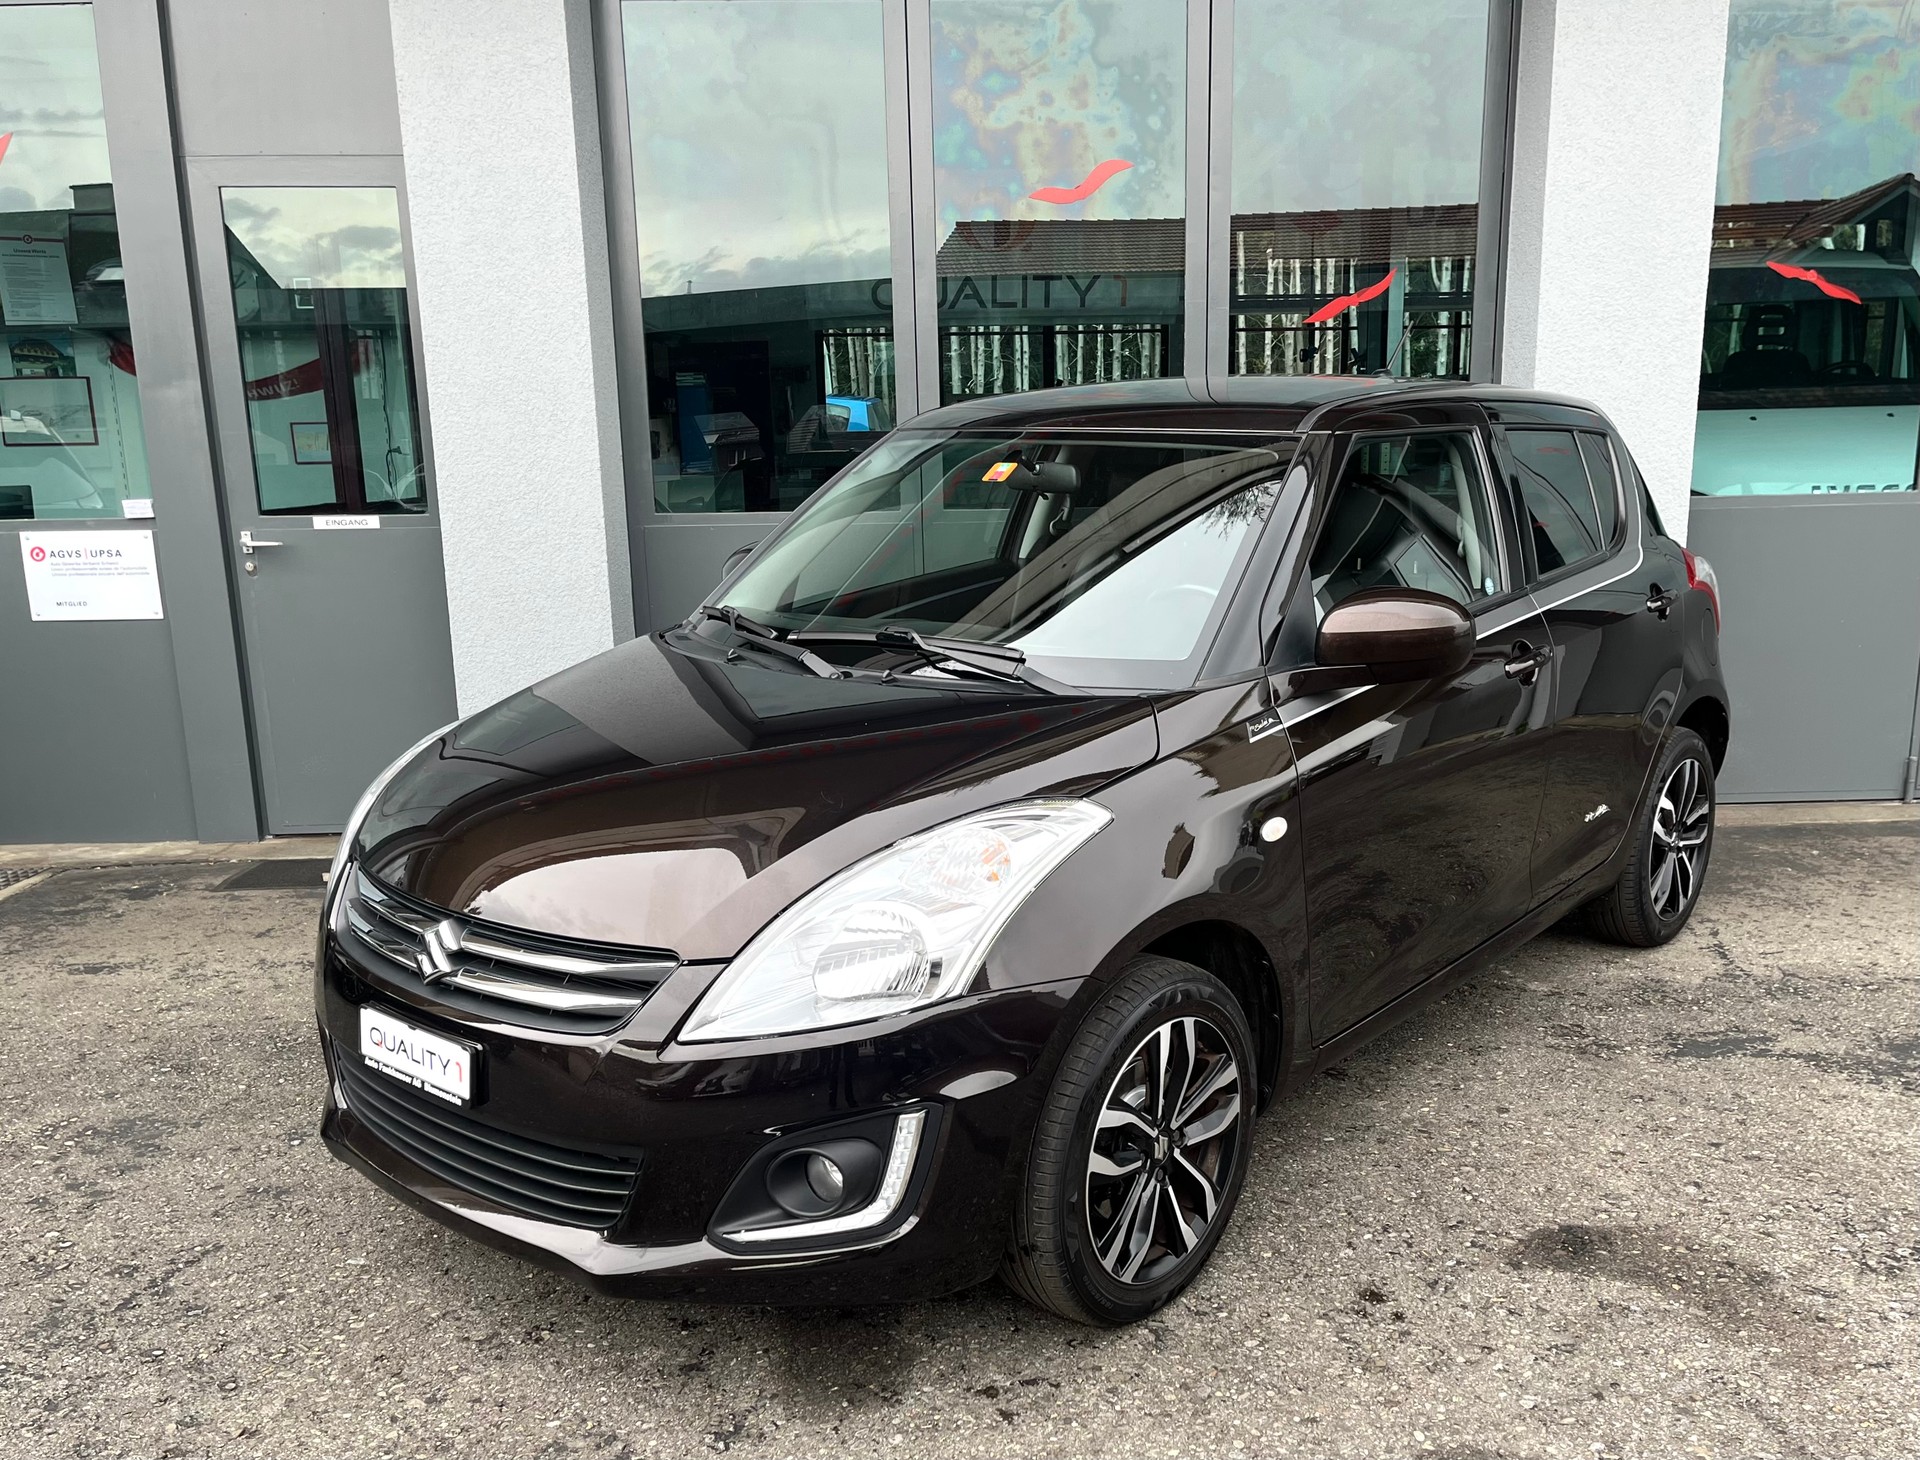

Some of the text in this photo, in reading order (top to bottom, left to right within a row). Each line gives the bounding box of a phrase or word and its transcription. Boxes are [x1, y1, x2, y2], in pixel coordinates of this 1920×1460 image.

[49, 549, 122, 559] AGVS UPSA
[370, 1026, 450, 1076] QUALITY
